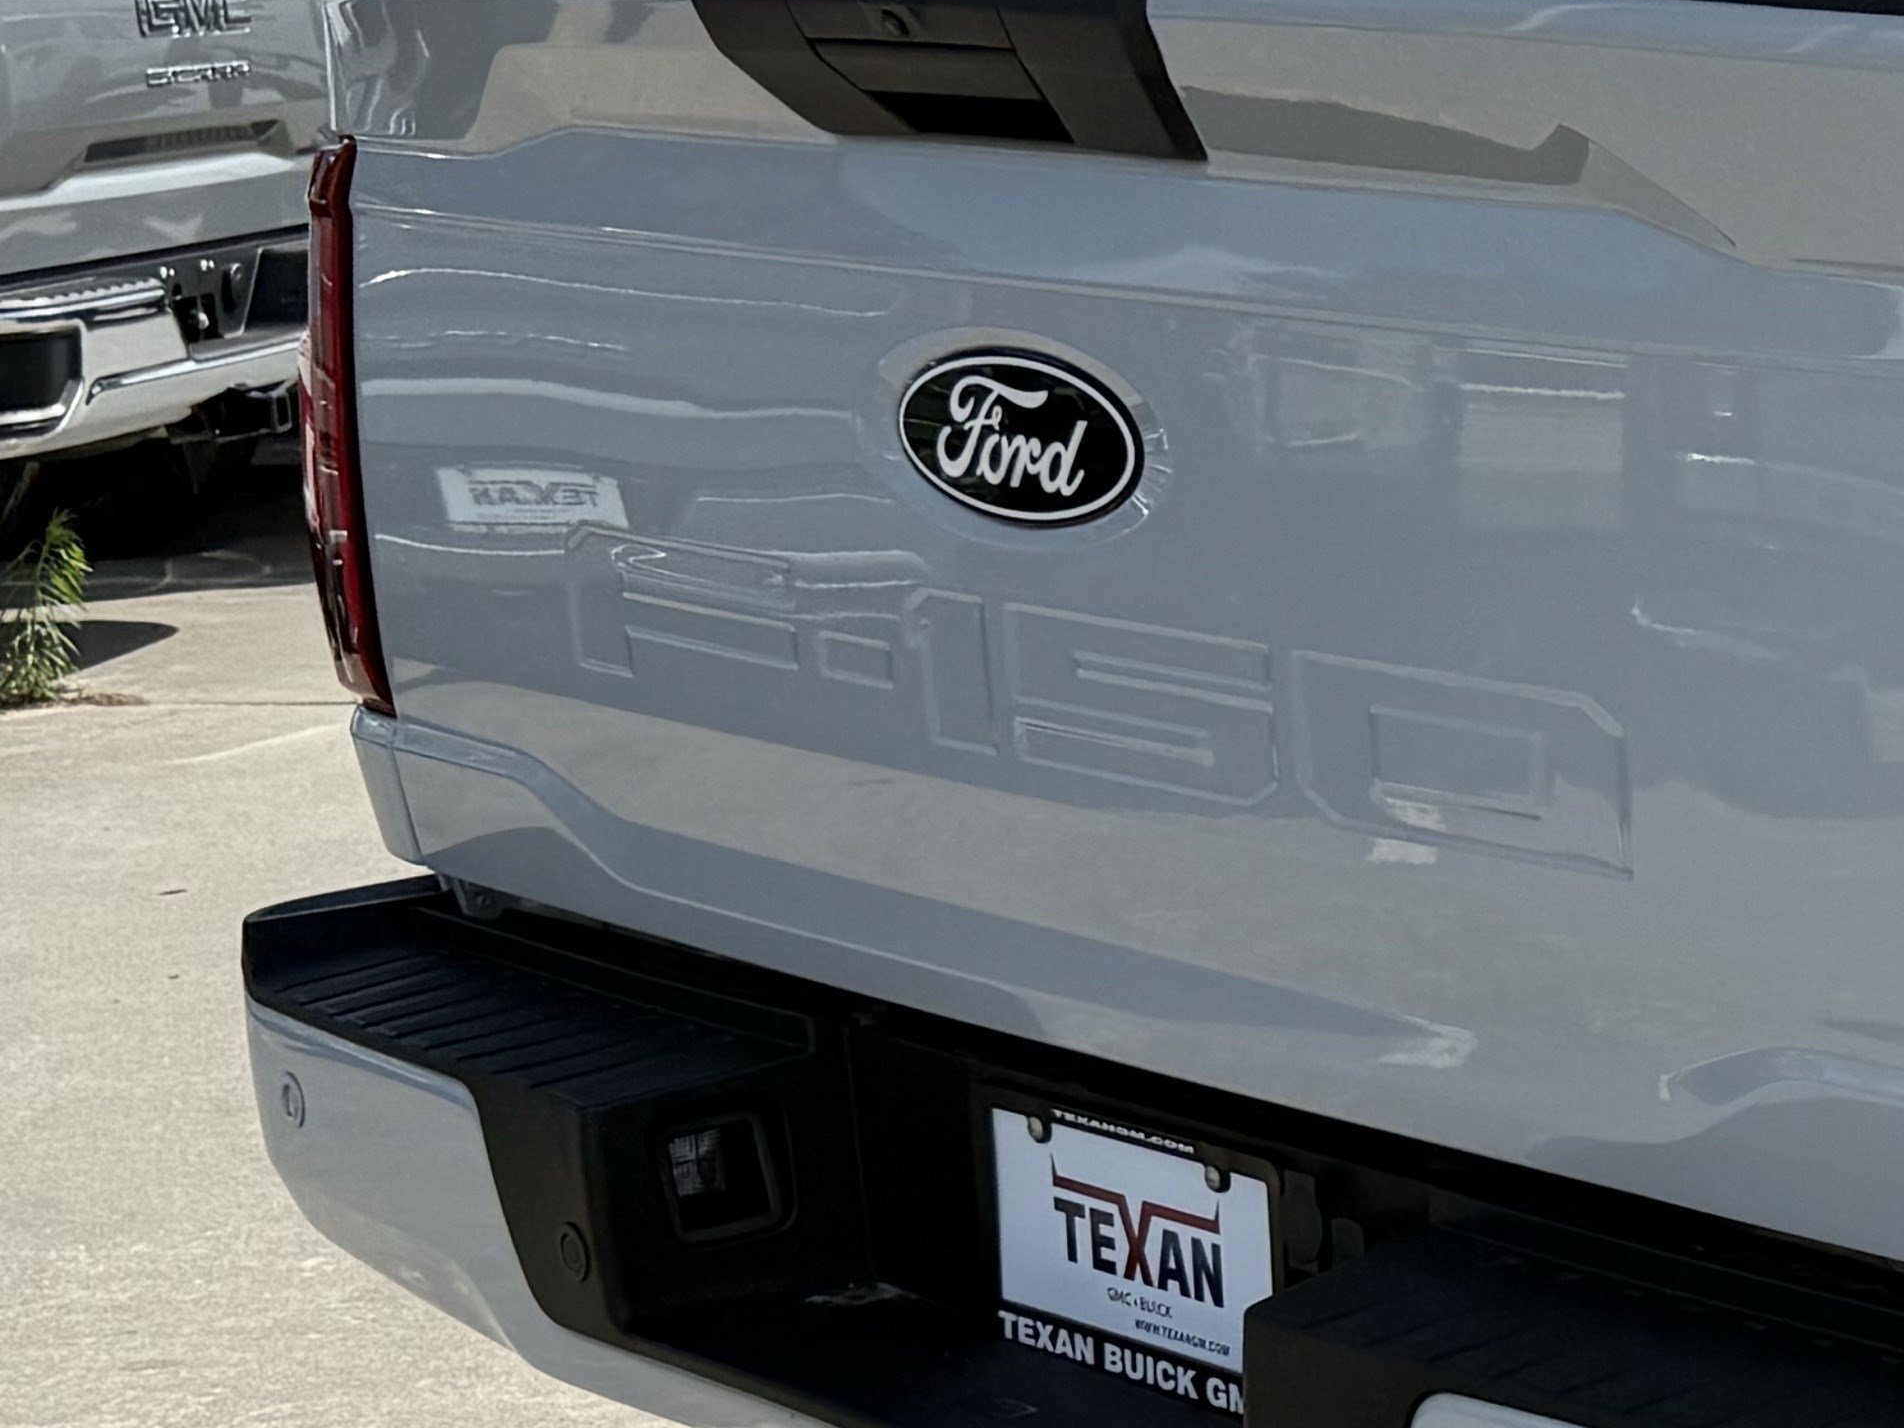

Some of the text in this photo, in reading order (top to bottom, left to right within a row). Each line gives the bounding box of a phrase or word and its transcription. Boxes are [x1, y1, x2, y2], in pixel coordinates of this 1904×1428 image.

[937, 375, 1088, 497] Ford
[563, 520, 1634, 880] F-150
[1052, 1110, 1195, 1153] TEXANGM.COM
[1052, 1156, 1225, 1308] TEXAN
[999, 1311, 1095, 1365] TEXAN
[1104, 1344, 1198, 1400] BUICK
